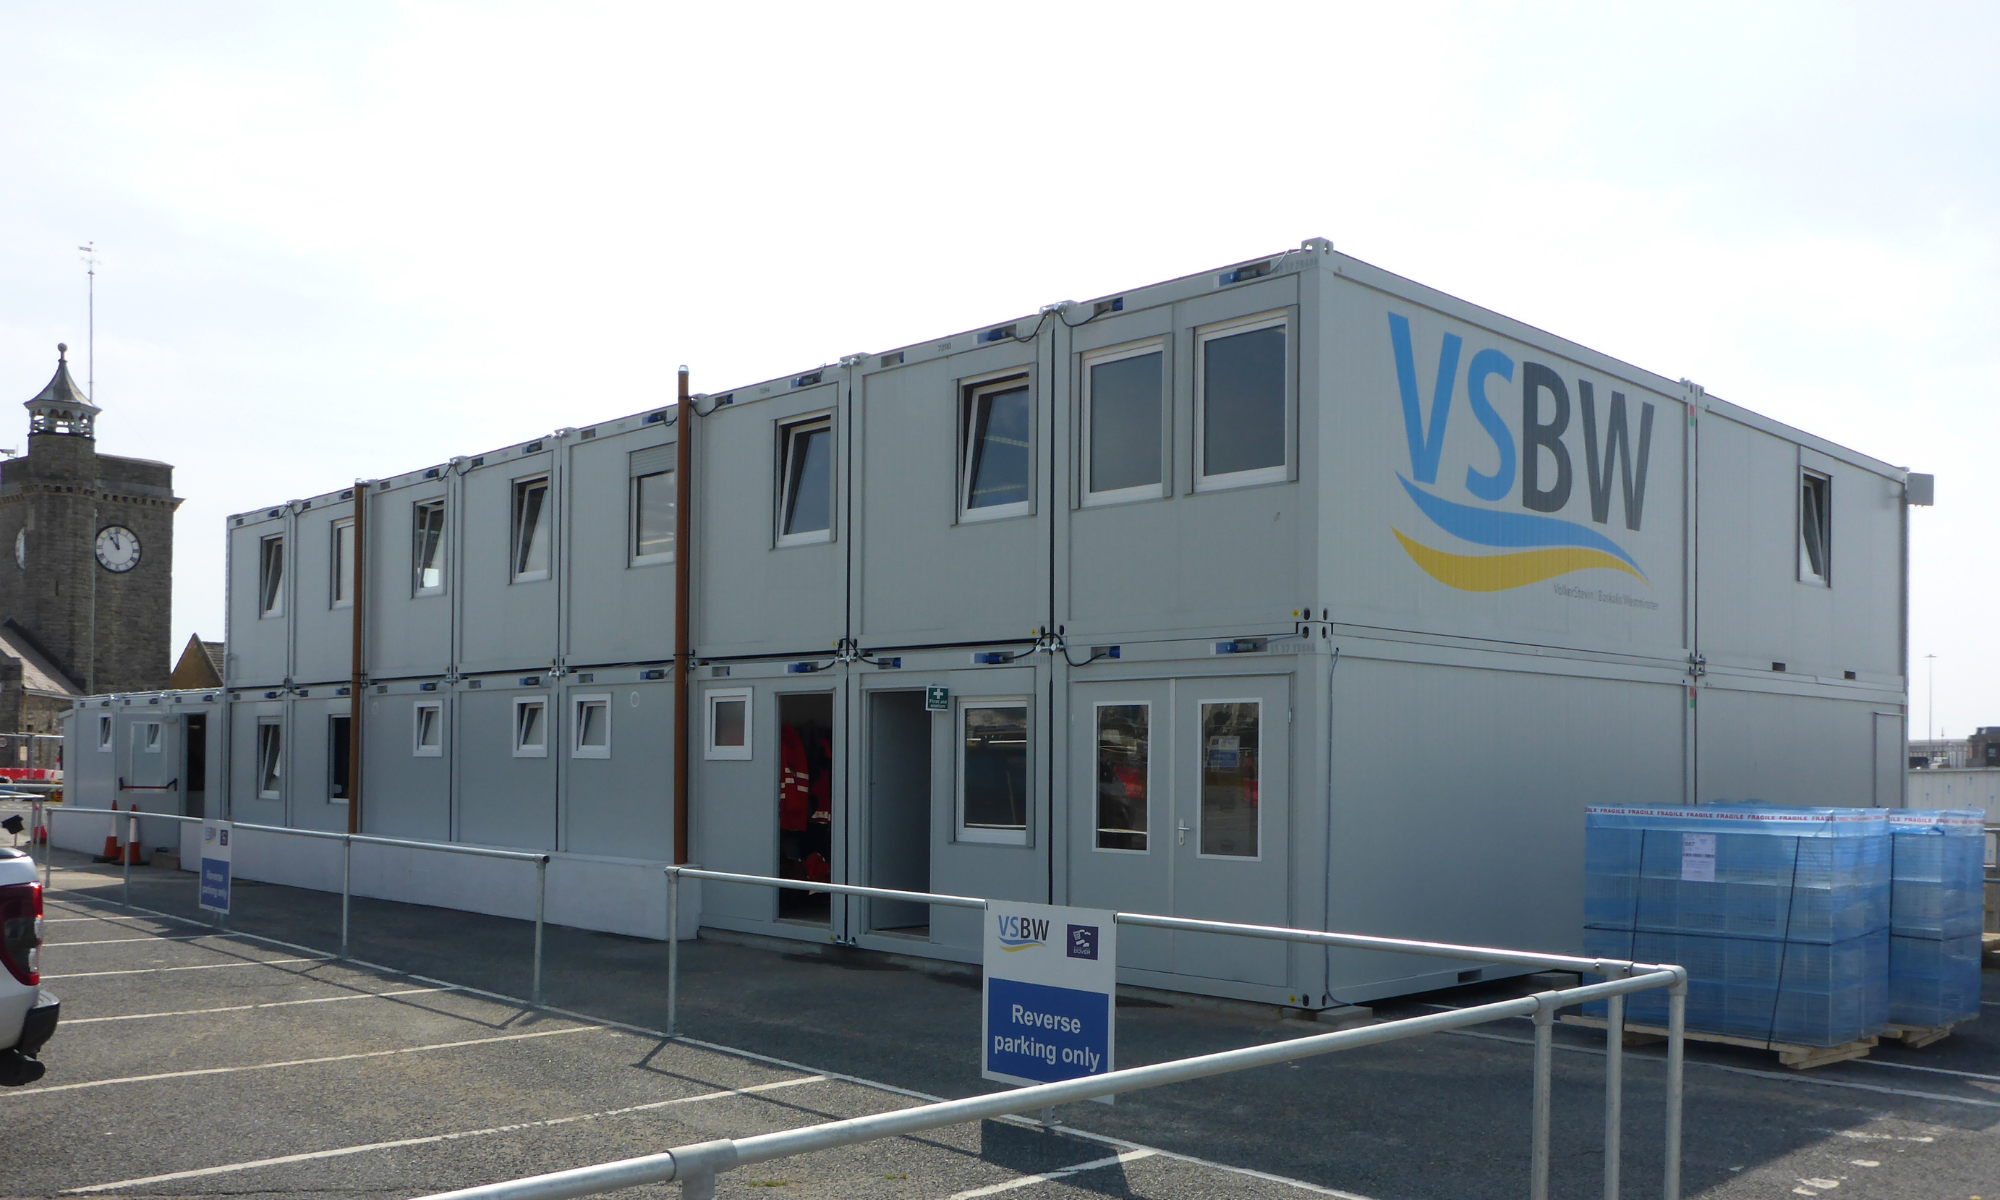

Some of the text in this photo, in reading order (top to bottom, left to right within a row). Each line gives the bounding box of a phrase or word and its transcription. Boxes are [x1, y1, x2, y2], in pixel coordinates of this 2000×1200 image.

[1387, 311, 1655, 532] VSBW
[998, 915, 1050, 941] VSBW
[1012, 1004, 1081, 1034] Reverse
[994, 1035, 1101, 1073] parking only
